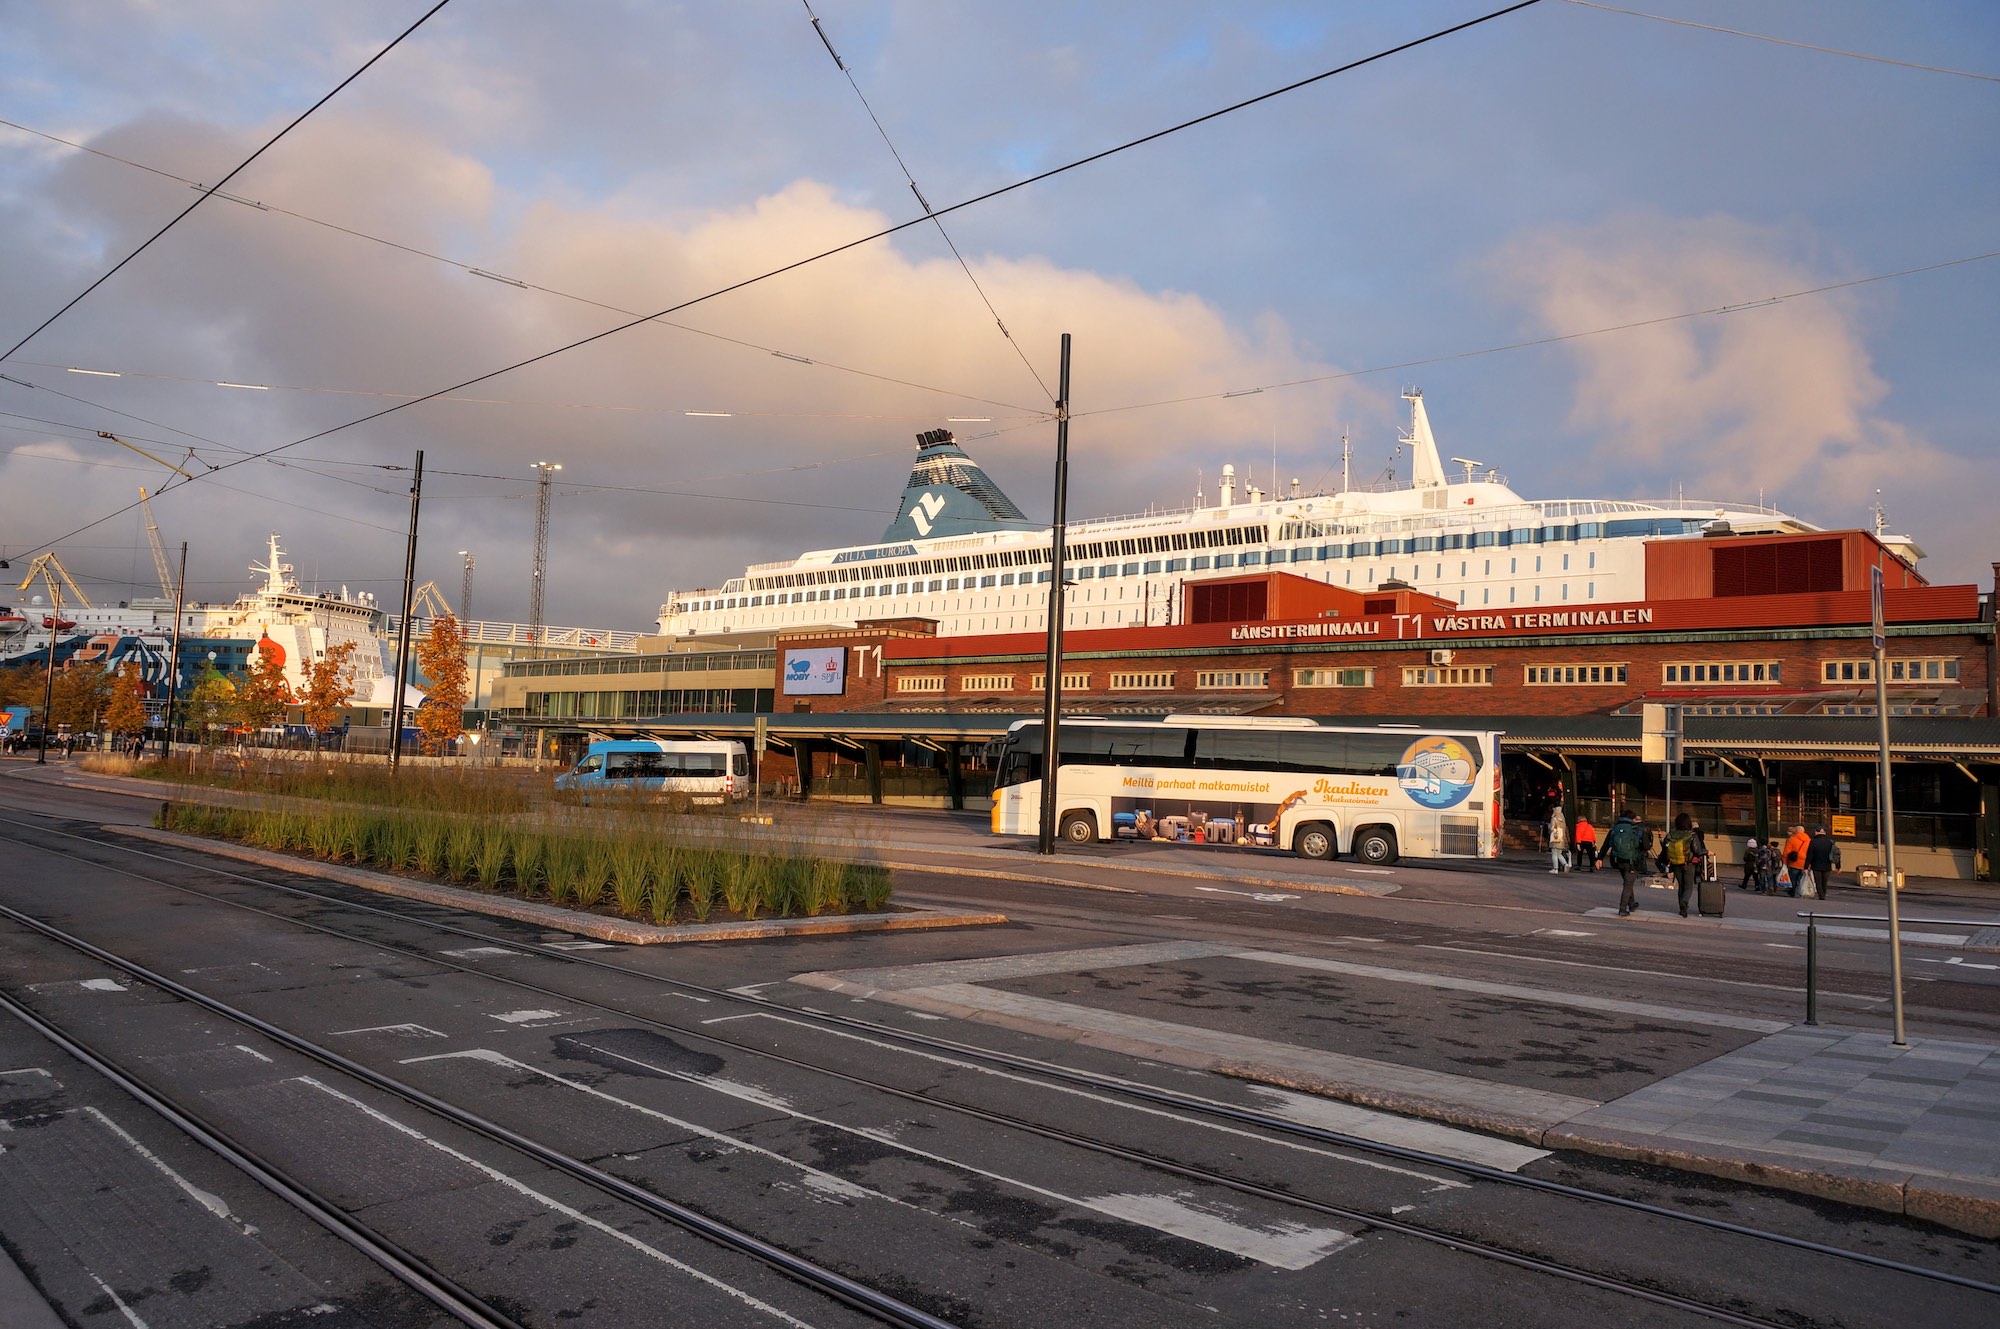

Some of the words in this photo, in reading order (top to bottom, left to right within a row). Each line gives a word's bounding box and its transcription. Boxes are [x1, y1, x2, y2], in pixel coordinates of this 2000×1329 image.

[839, 550, 867, 562] SILJA
[875, 545, 911, 558] EUROPA
[1231, 620, 1379, 640] LÄNSITERMINAALI
[1392, 613, 1422, 640] T1
[1433, 613, 1506, 632] VÄSTRA
[1511, 607, 1653, 629] TERMINALEN
[853, 644, 883, 678] T1
[786, 673, 810, 681] MOBY
[1122, 776, 1154, 788] Meiltä
[1156, 779, 1196, 791] parhaat
[1198, 780, 1270, 793] matkamuistot
[1313, 778, 1389, 796] Ikaalisten
[1322, 794, 1380, 805] Matkatoimisto
